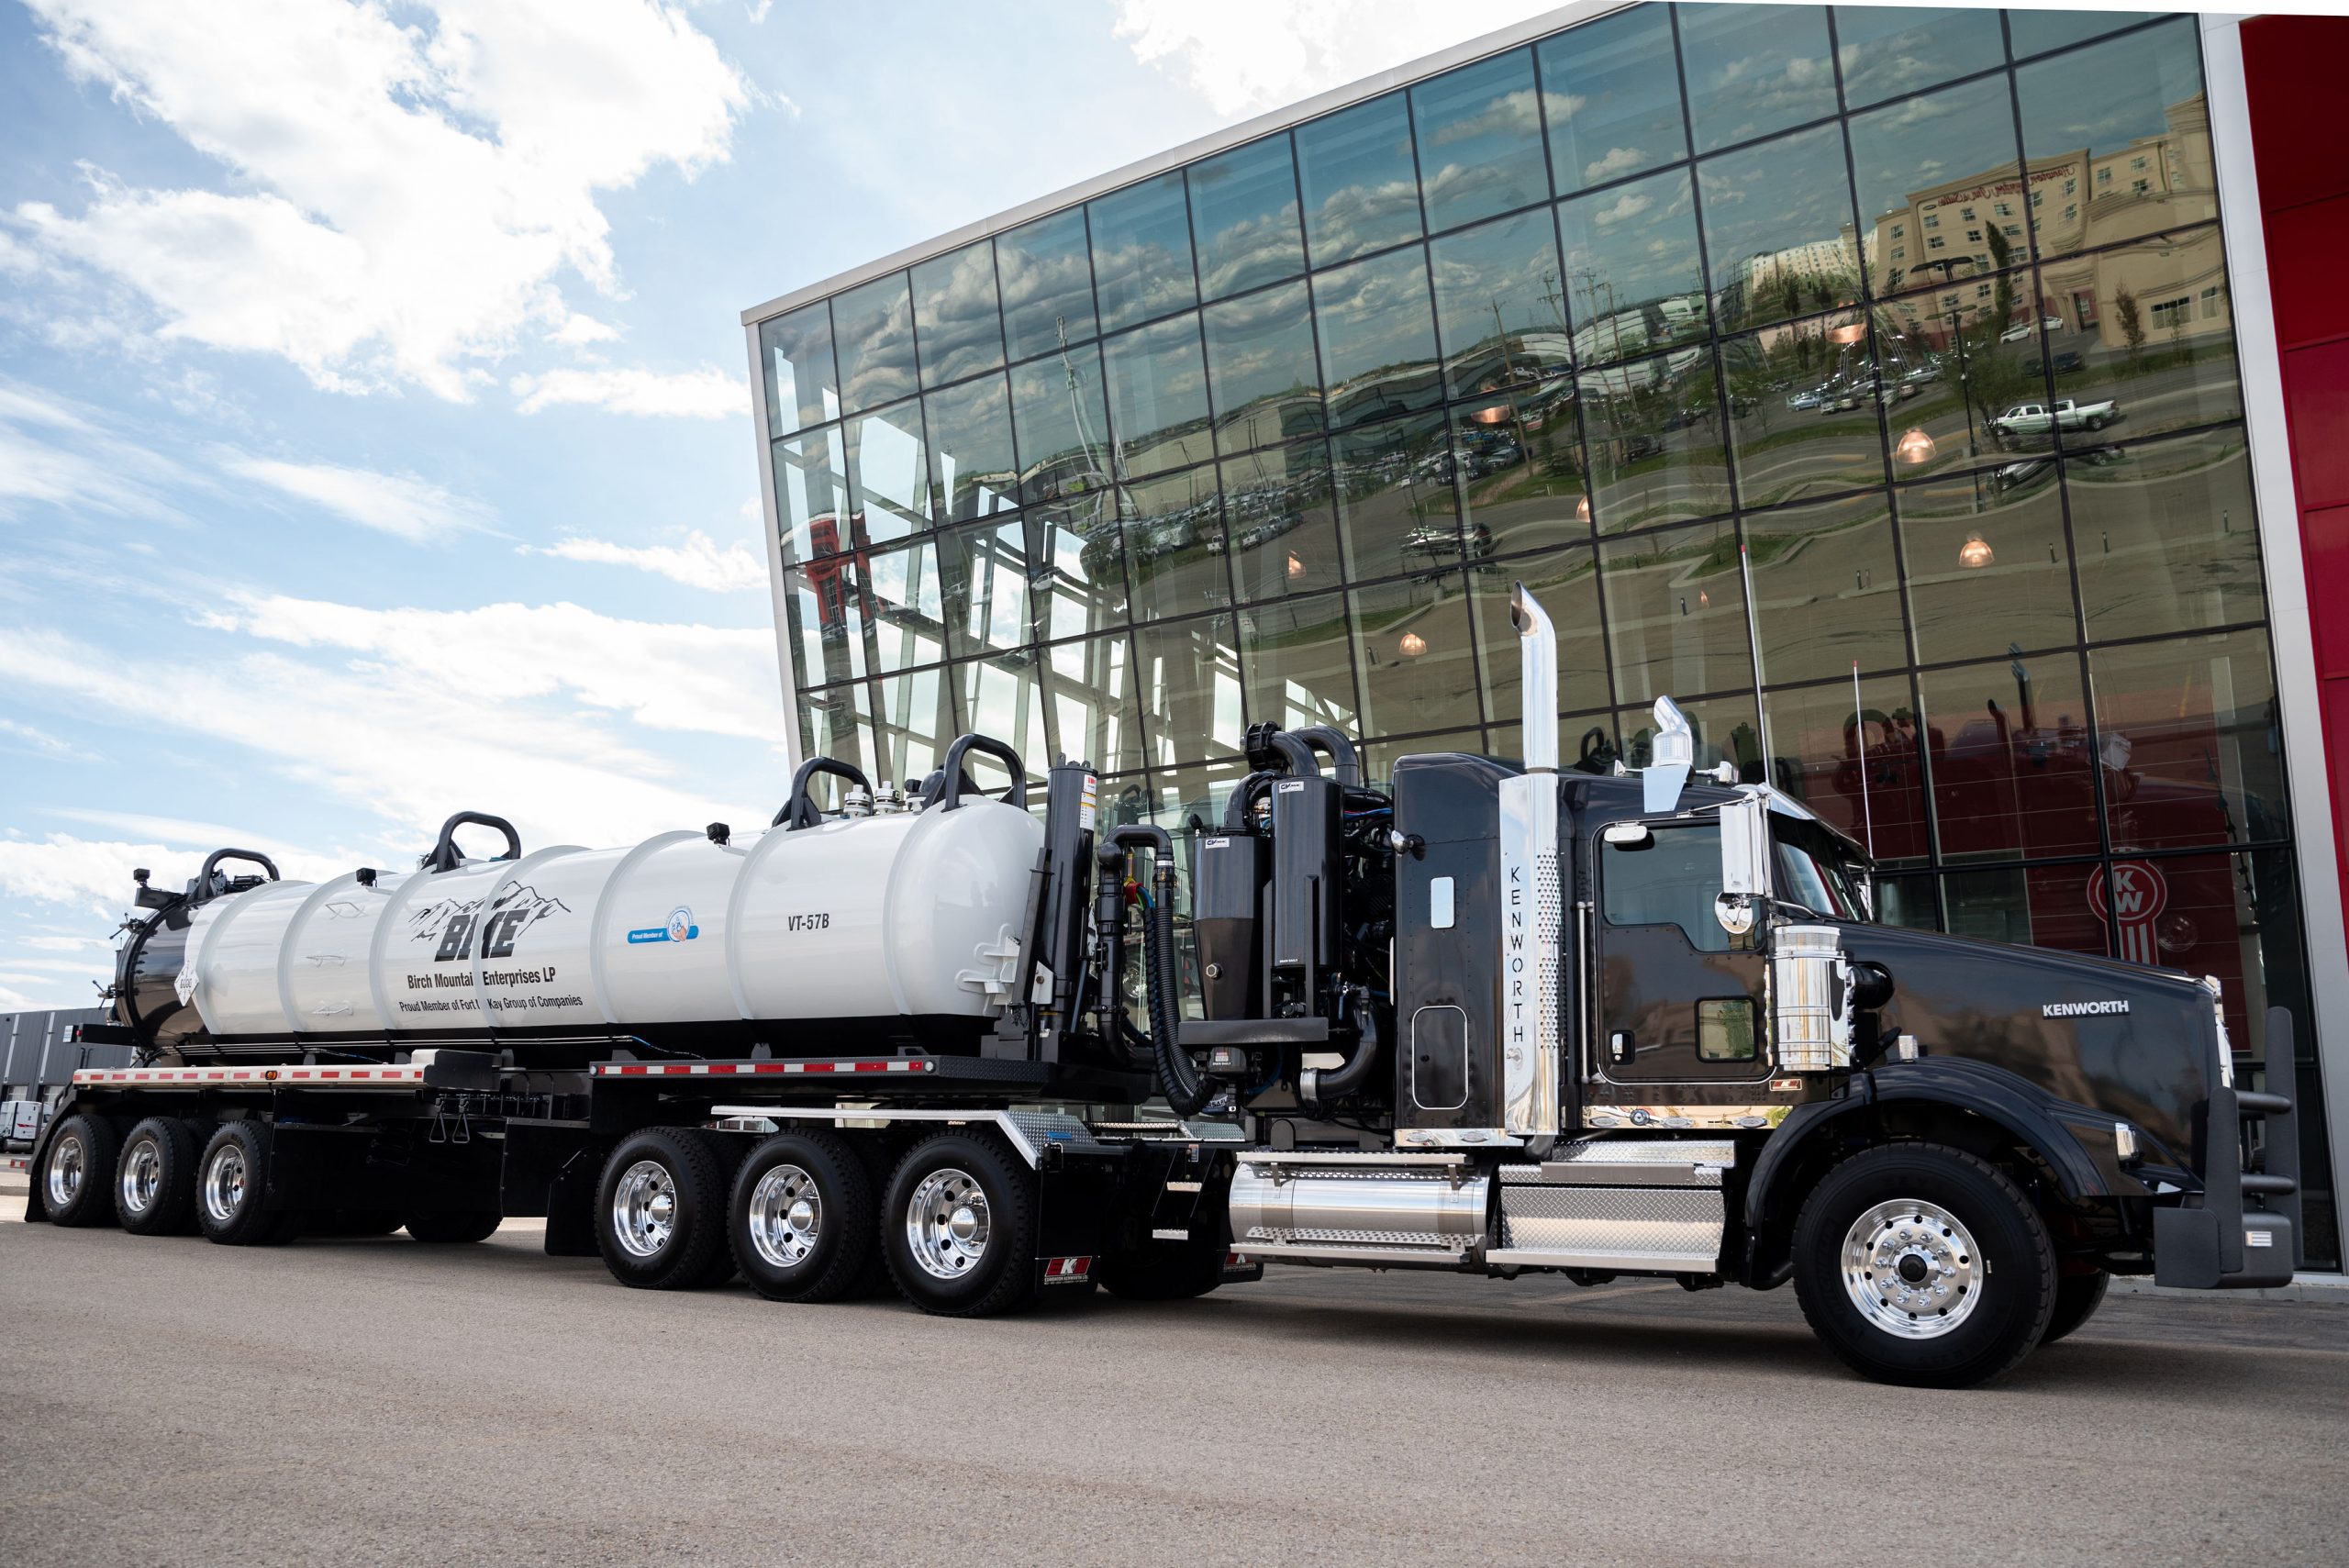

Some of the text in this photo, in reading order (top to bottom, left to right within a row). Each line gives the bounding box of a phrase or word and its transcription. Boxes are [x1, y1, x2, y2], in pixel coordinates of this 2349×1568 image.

[788, 913, 829, 931] VT-57B
[1510, 866, 1524, 1042] KENWORTH
[406, 967, 556, 989] Birch Mountai Enterprises LP
[398, 1000, 421, 1012] Proud
[420, 999, 451, 1011] Member
[451, 999, 459, 1011] of
[460, 999, 476, 1010] Fort
[503, 997, 528, 1009] Group
[528, 996, 538, 1008] of
[537, 995, 584, 1008] Companies
[2043, 1000, 2130, 1017] KENWORTH
